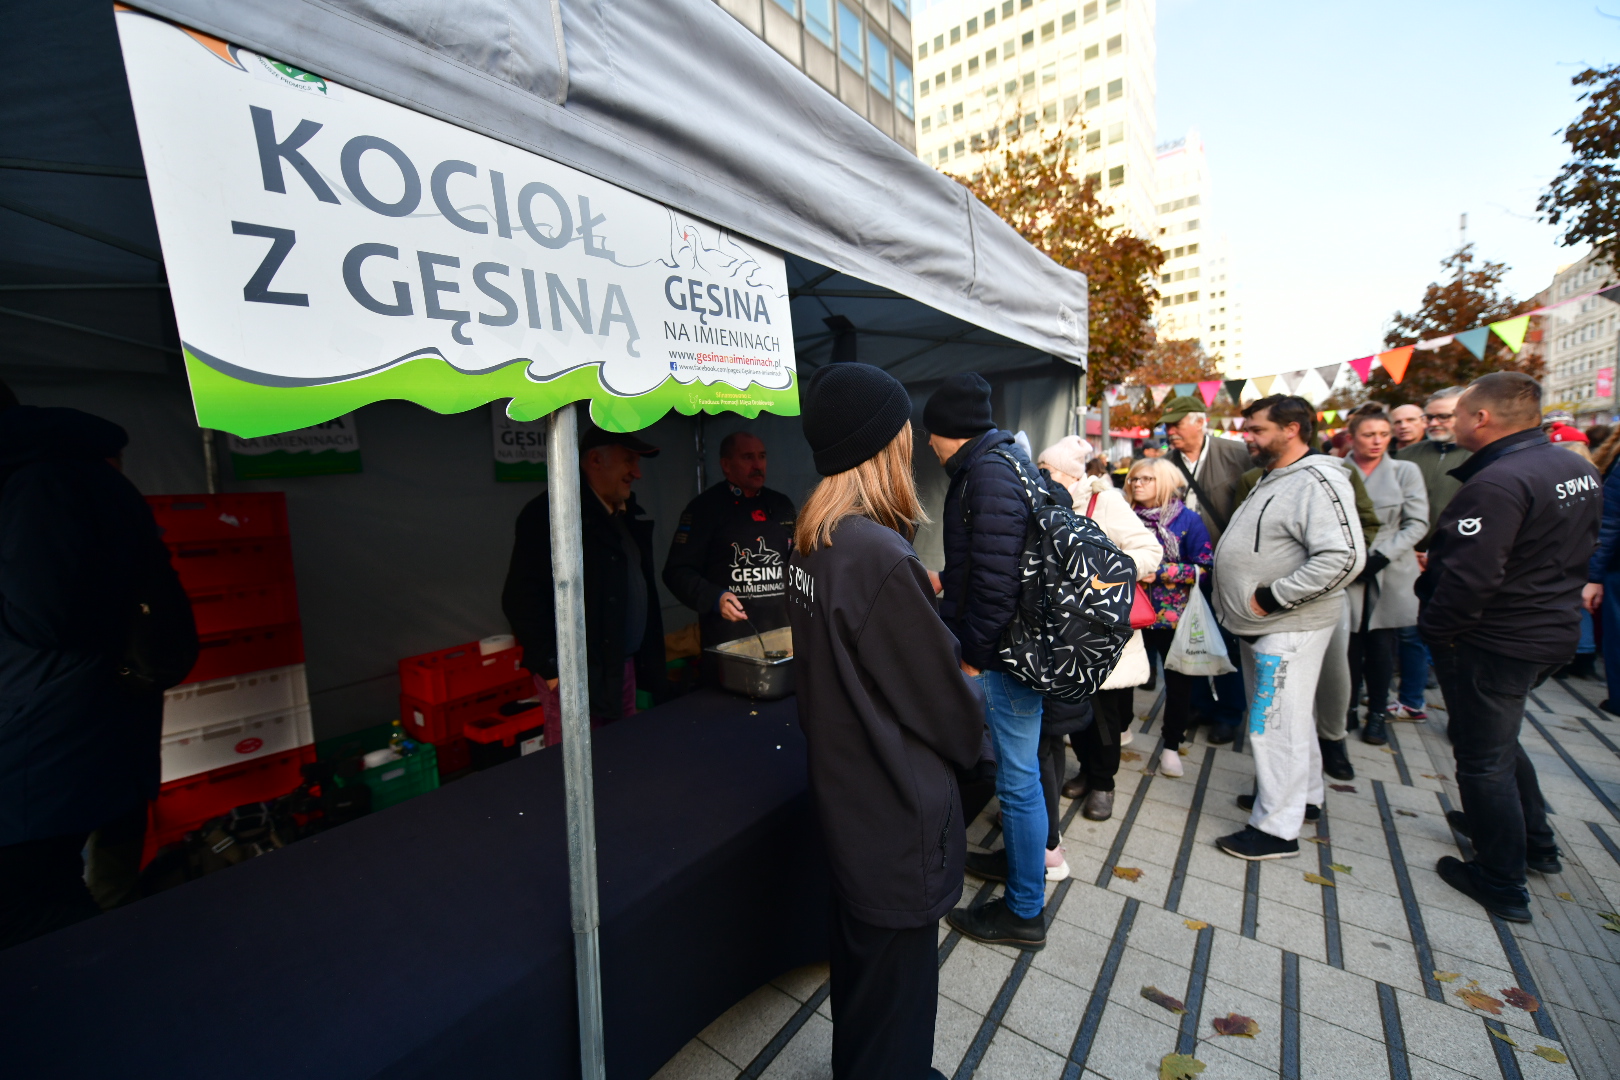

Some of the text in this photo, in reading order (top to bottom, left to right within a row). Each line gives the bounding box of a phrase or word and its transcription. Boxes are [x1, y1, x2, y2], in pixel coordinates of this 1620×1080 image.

[249, 105, 616, 261] KOCIOŁ
[231, 220, 641, 358] Z GĘSINĄ
[664, 275, 771, 325] GĘSINA
[664, 321, 780, 352] NA IMIENINACH
[668, 350, 781, 369] www.gesinanaimieninach.pl
[234, 434, 353, 449] NA IMIENINACH
[1555, 474, 1599, 500] SOWA
[728, 585, 742, 593] NA
[731, 566, 783, 586] GĘSINA
